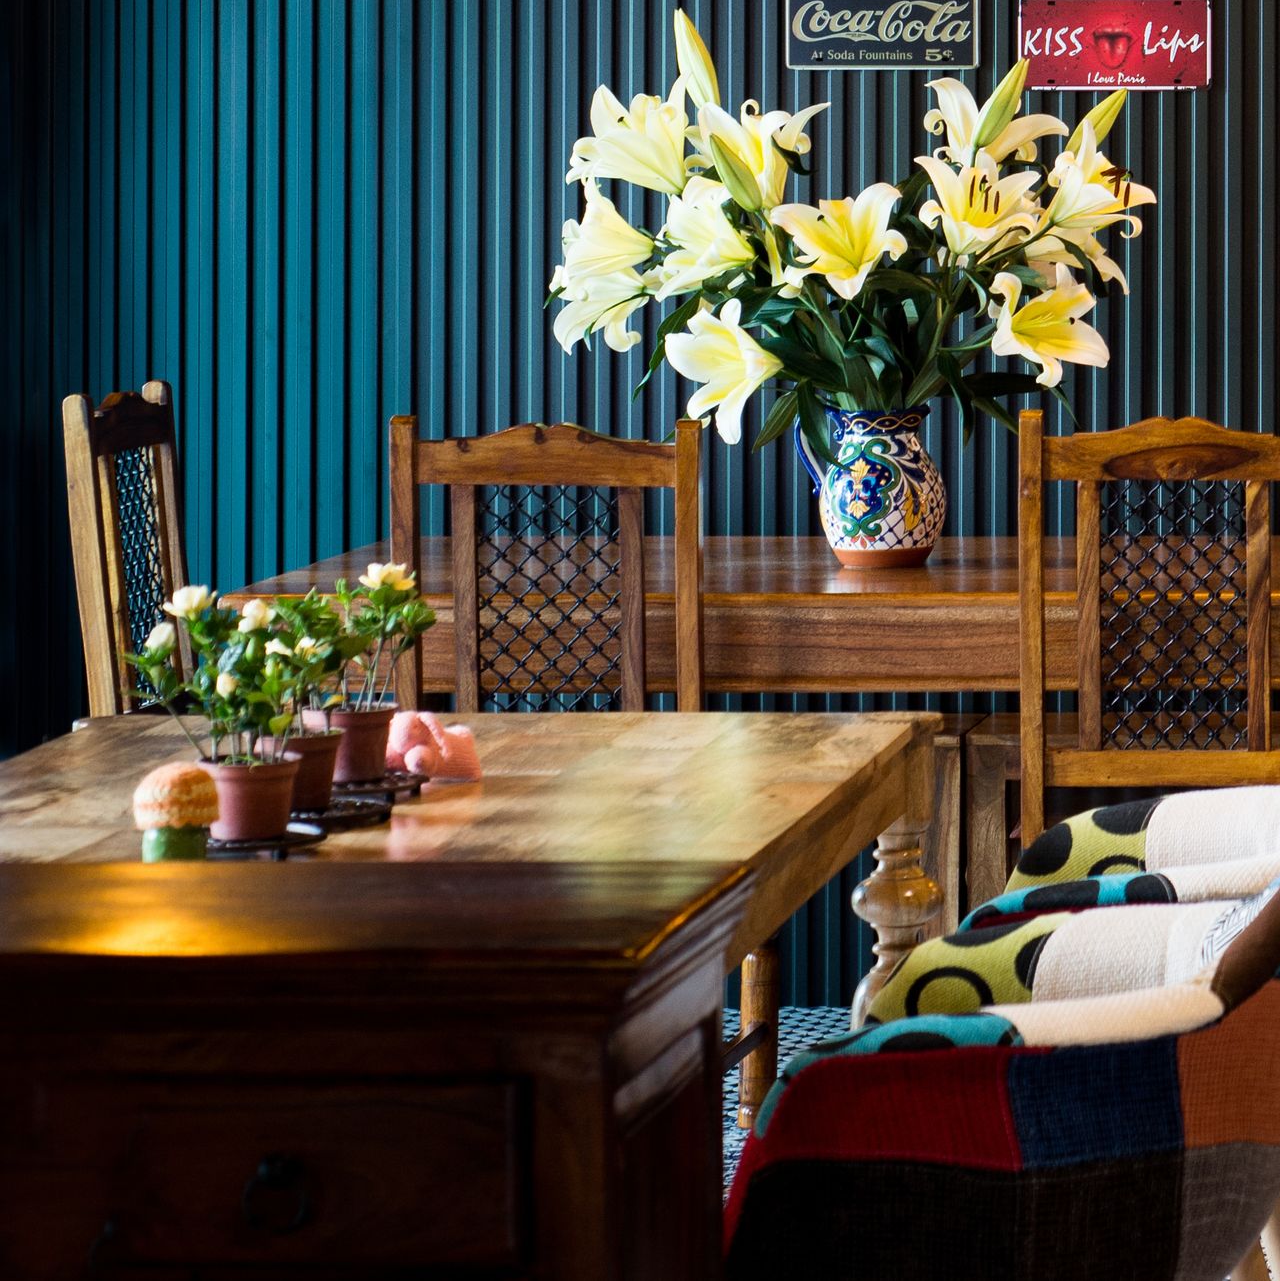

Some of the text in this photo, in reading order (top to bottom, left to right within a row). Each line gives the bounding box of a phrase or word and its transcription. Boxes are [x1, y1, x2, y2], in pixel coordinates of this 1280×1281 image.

[792, 0, 972, 43] Coca-Cola
[810, 50, 824, 61] At
[827, 50, 855, 60] Soda
[859, 50, 913, 60] Fountains
[1023, 21, 1205, 63] KISS Lips
[1087, 72, 1146, 85] I love Paris
